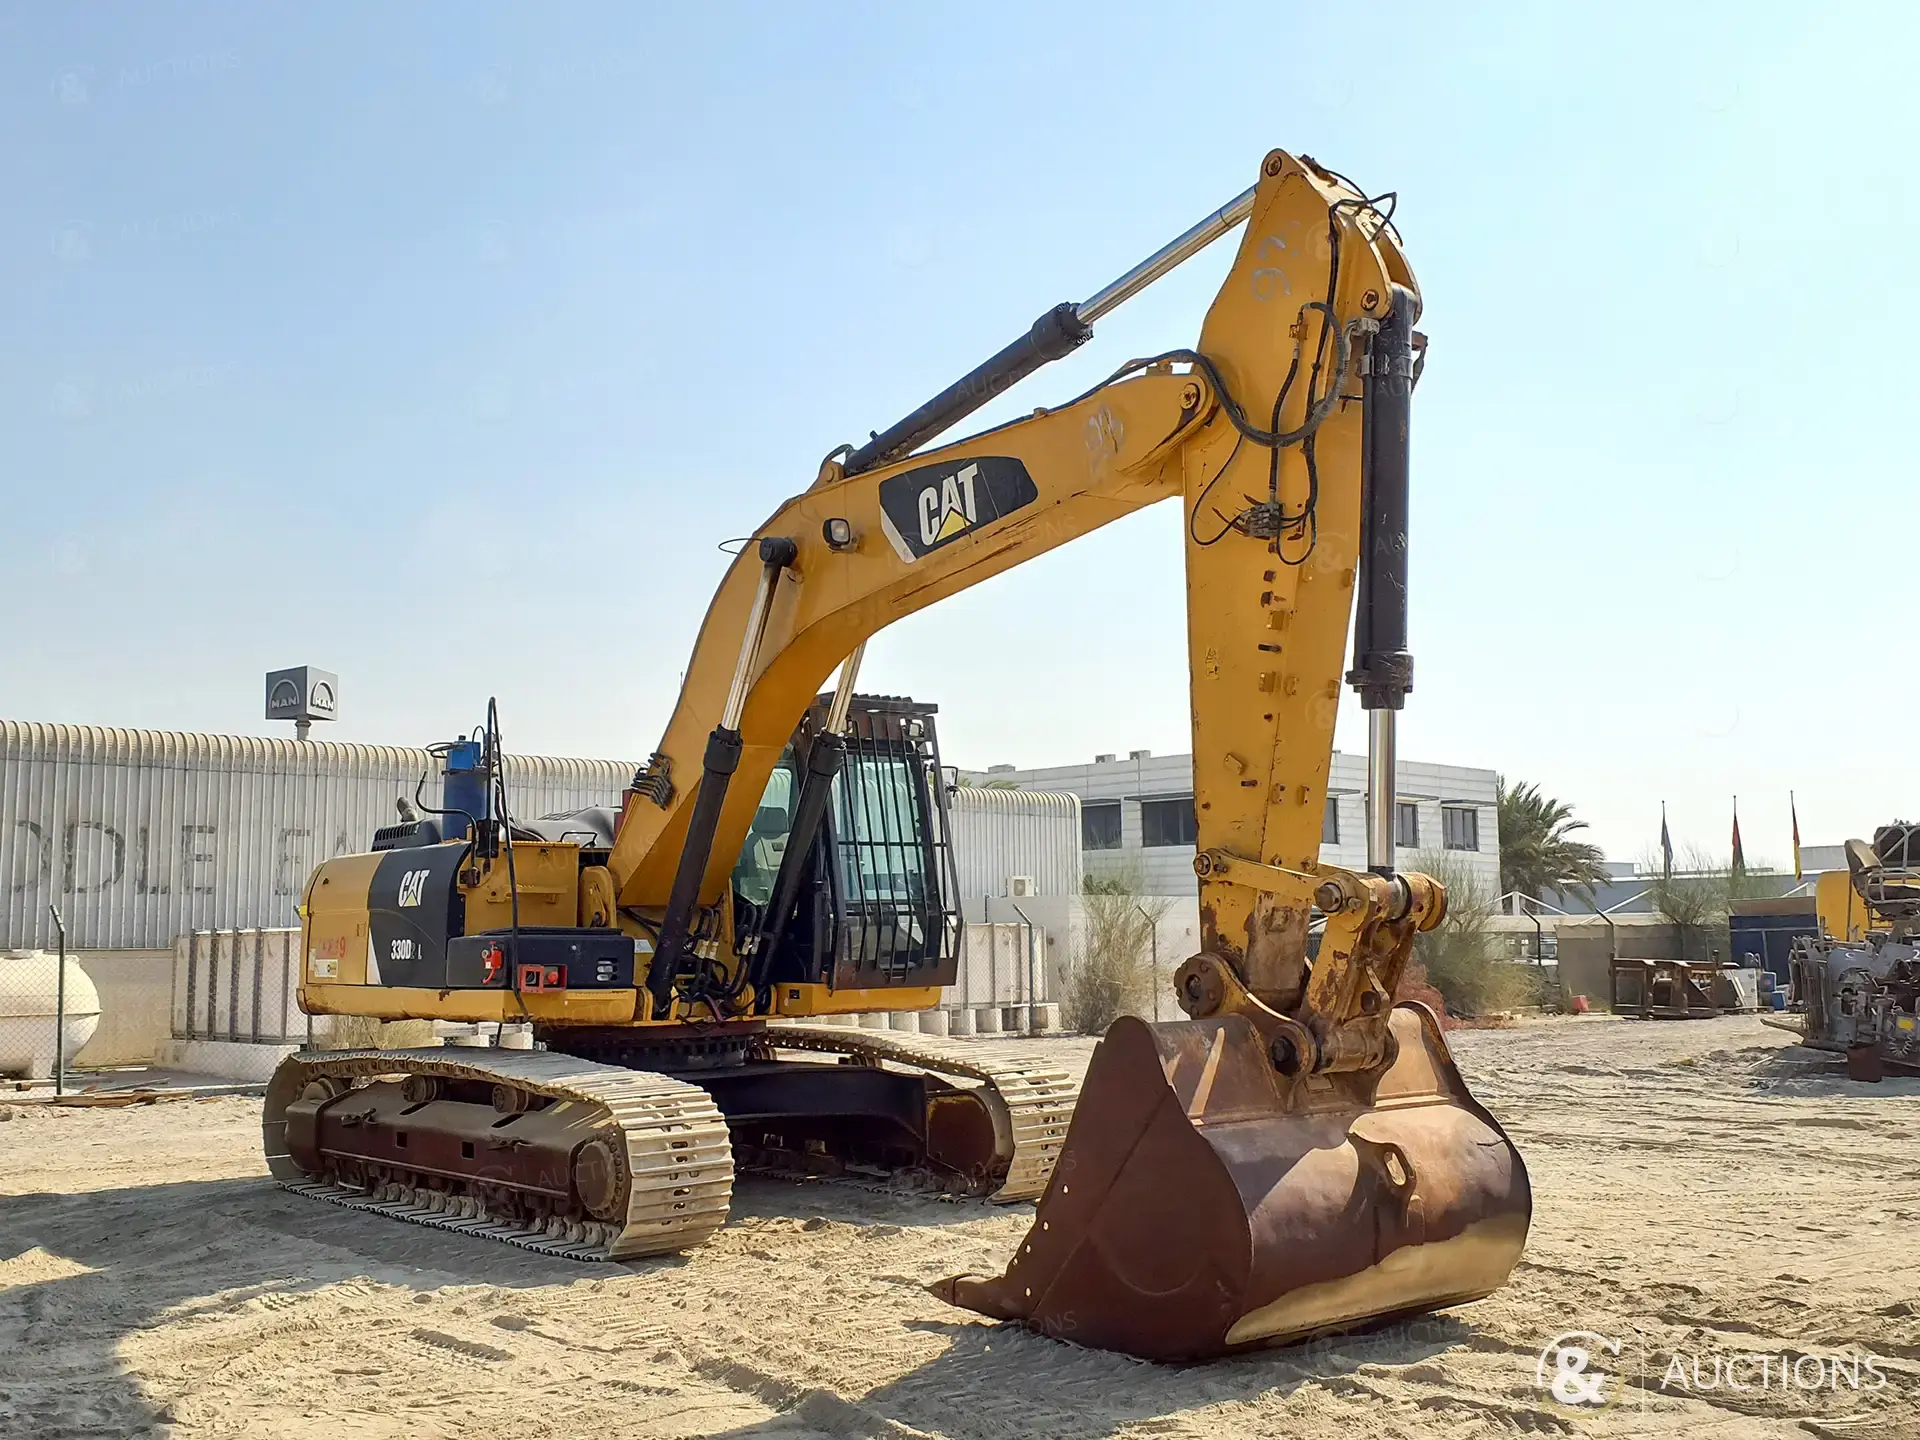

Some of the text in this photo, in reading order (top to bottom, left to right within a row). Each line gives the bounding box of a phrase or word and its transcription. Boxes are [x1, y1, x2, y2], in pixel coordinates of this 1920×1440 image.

[919, 463, 978, 546] CAT
[271, 696, 297, 708] MAN
[316, 697, 334, 709] MAN
[398, 869, 430, 907] CAT
